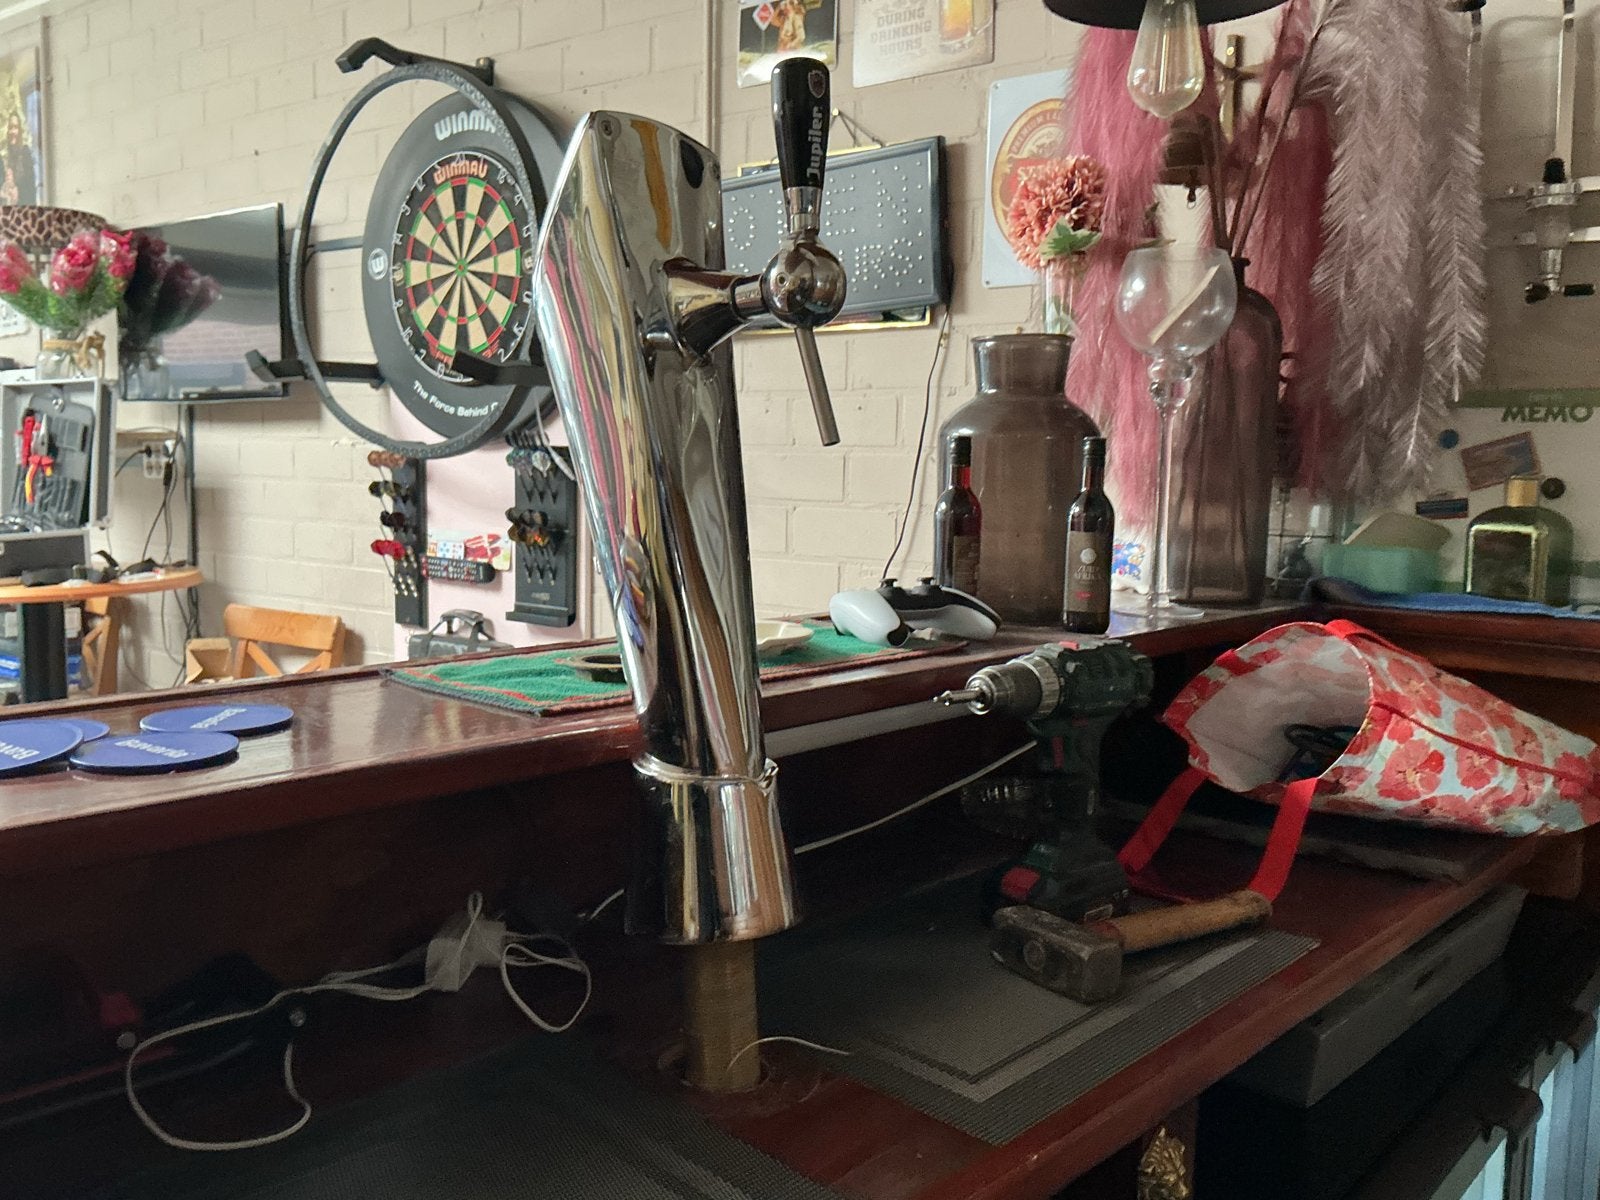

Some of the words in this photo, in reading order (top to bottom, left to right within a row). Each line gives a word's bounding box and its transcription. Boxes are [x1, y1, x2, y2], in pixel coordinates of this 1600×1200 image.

[877, 6, 925, 28] DURING
[870, 20, 932, 44] DRINKING
[880, 36, 922, 56] HOURS
[807, 106, 823, 180] Jupiler
[413, 379, 429, 399] The
[429, 395, 456, 415] Force
[457, 405, 489, 418] Behind
[1501, 402, 1594, 423] MEMO
